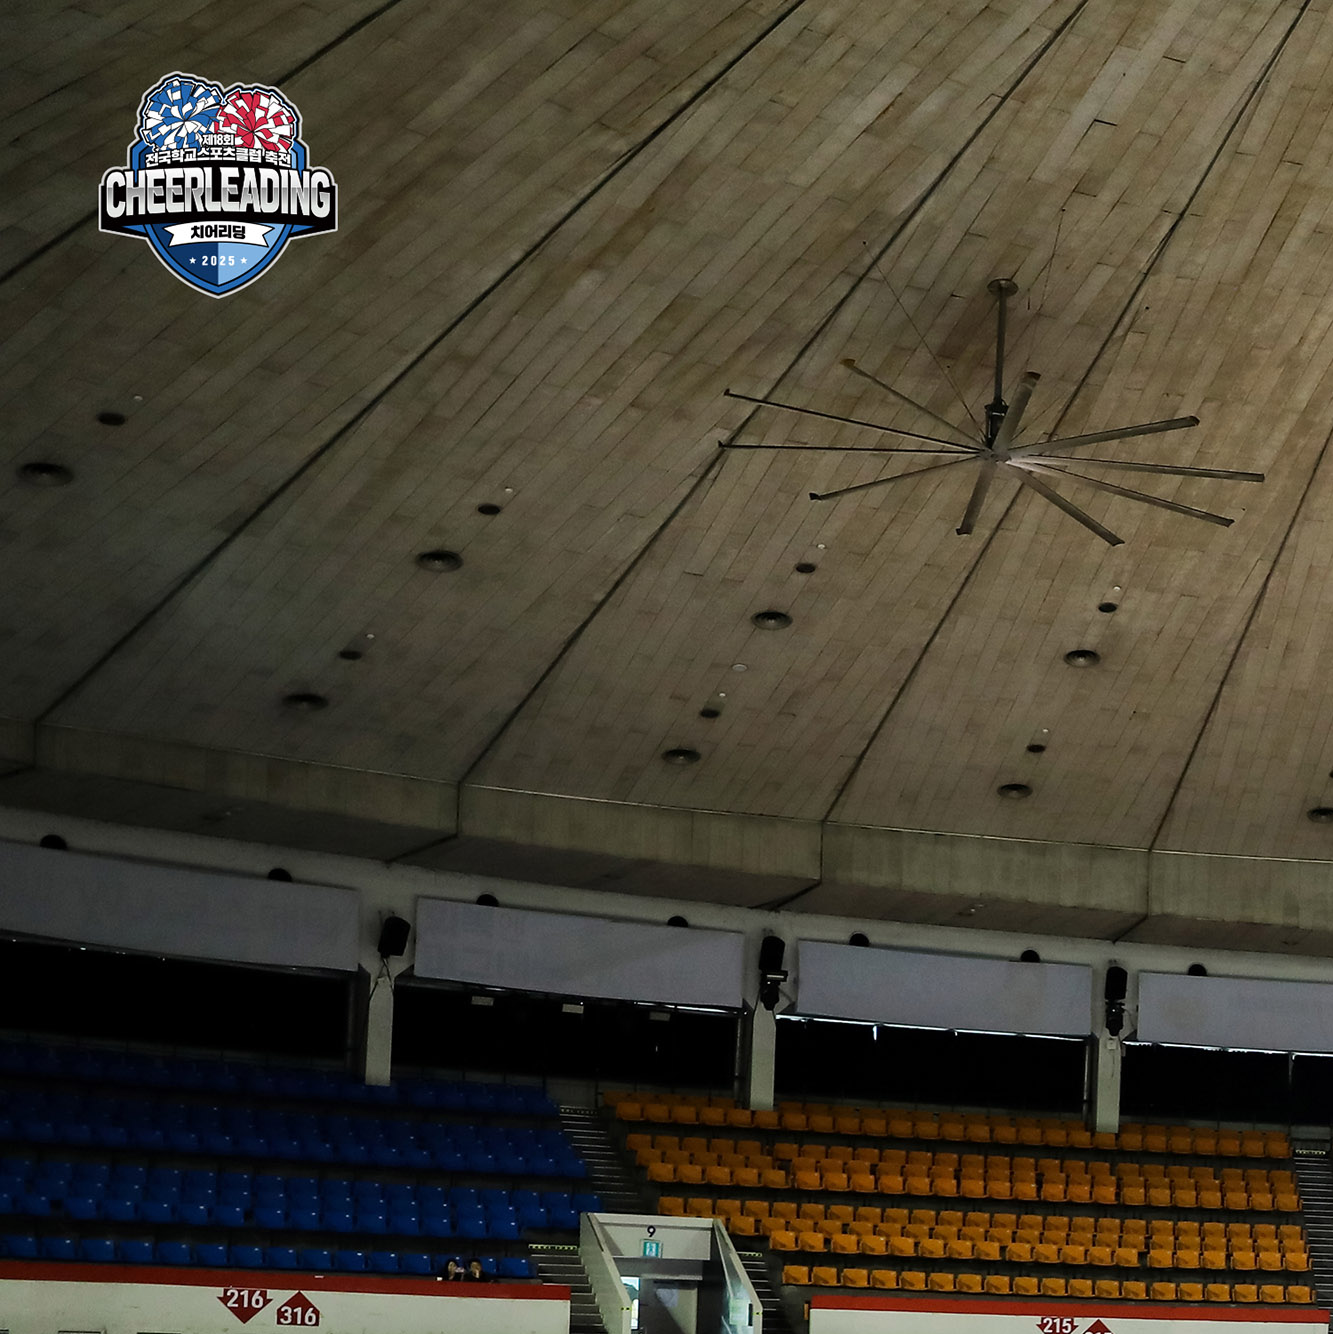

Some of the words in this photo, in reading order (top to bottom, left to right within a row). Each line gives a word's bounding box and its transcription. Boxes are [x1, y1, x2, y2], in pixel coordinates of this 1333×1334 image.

[647, 1225, 657, 1238] 9
[226, 1289, 264, 1309] 216
[280, 1305, 317, 1326] 316
[1042, 1317, 1072, 1334] 215
